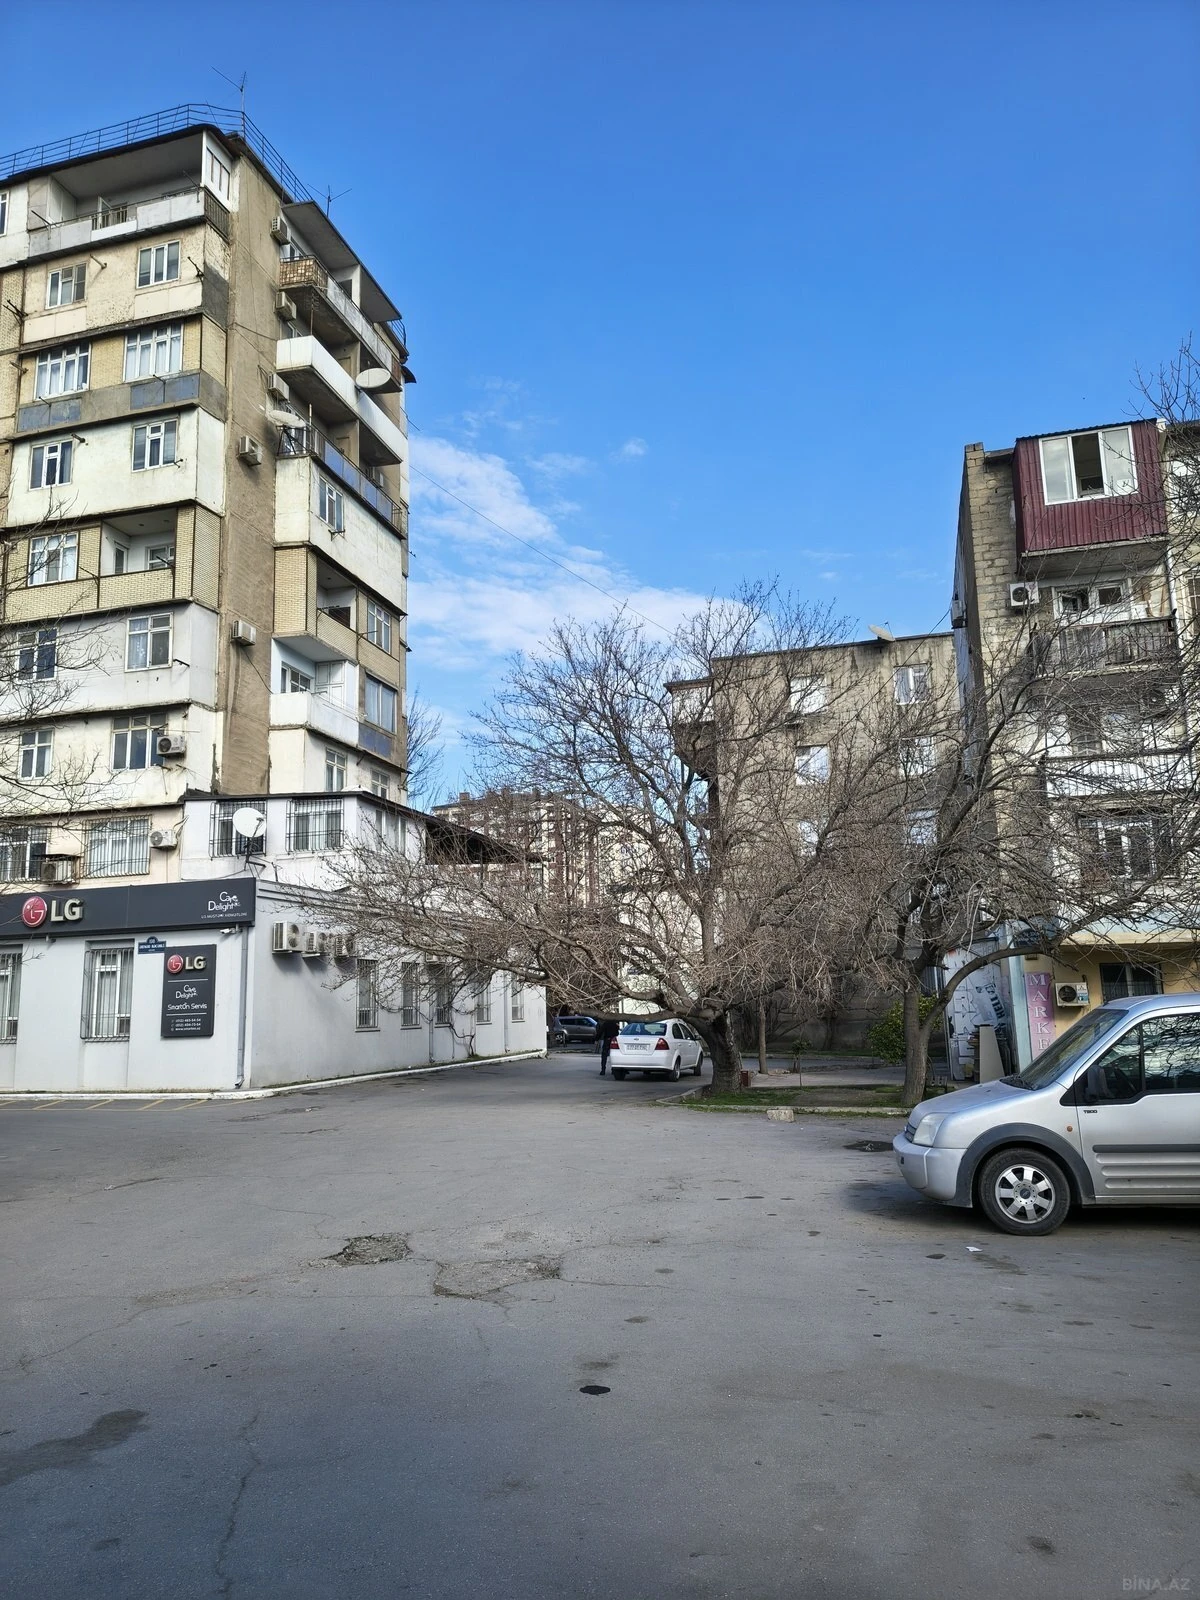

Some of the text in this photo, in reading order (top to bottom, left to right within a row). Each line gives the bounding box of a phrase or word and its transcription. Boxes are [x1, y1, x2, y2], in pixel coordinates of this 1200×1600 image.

[50, 898, 83, 921] LG
[185, 955, 206, 970] LG
[1029, 974, 1051, 1051] MARKE
